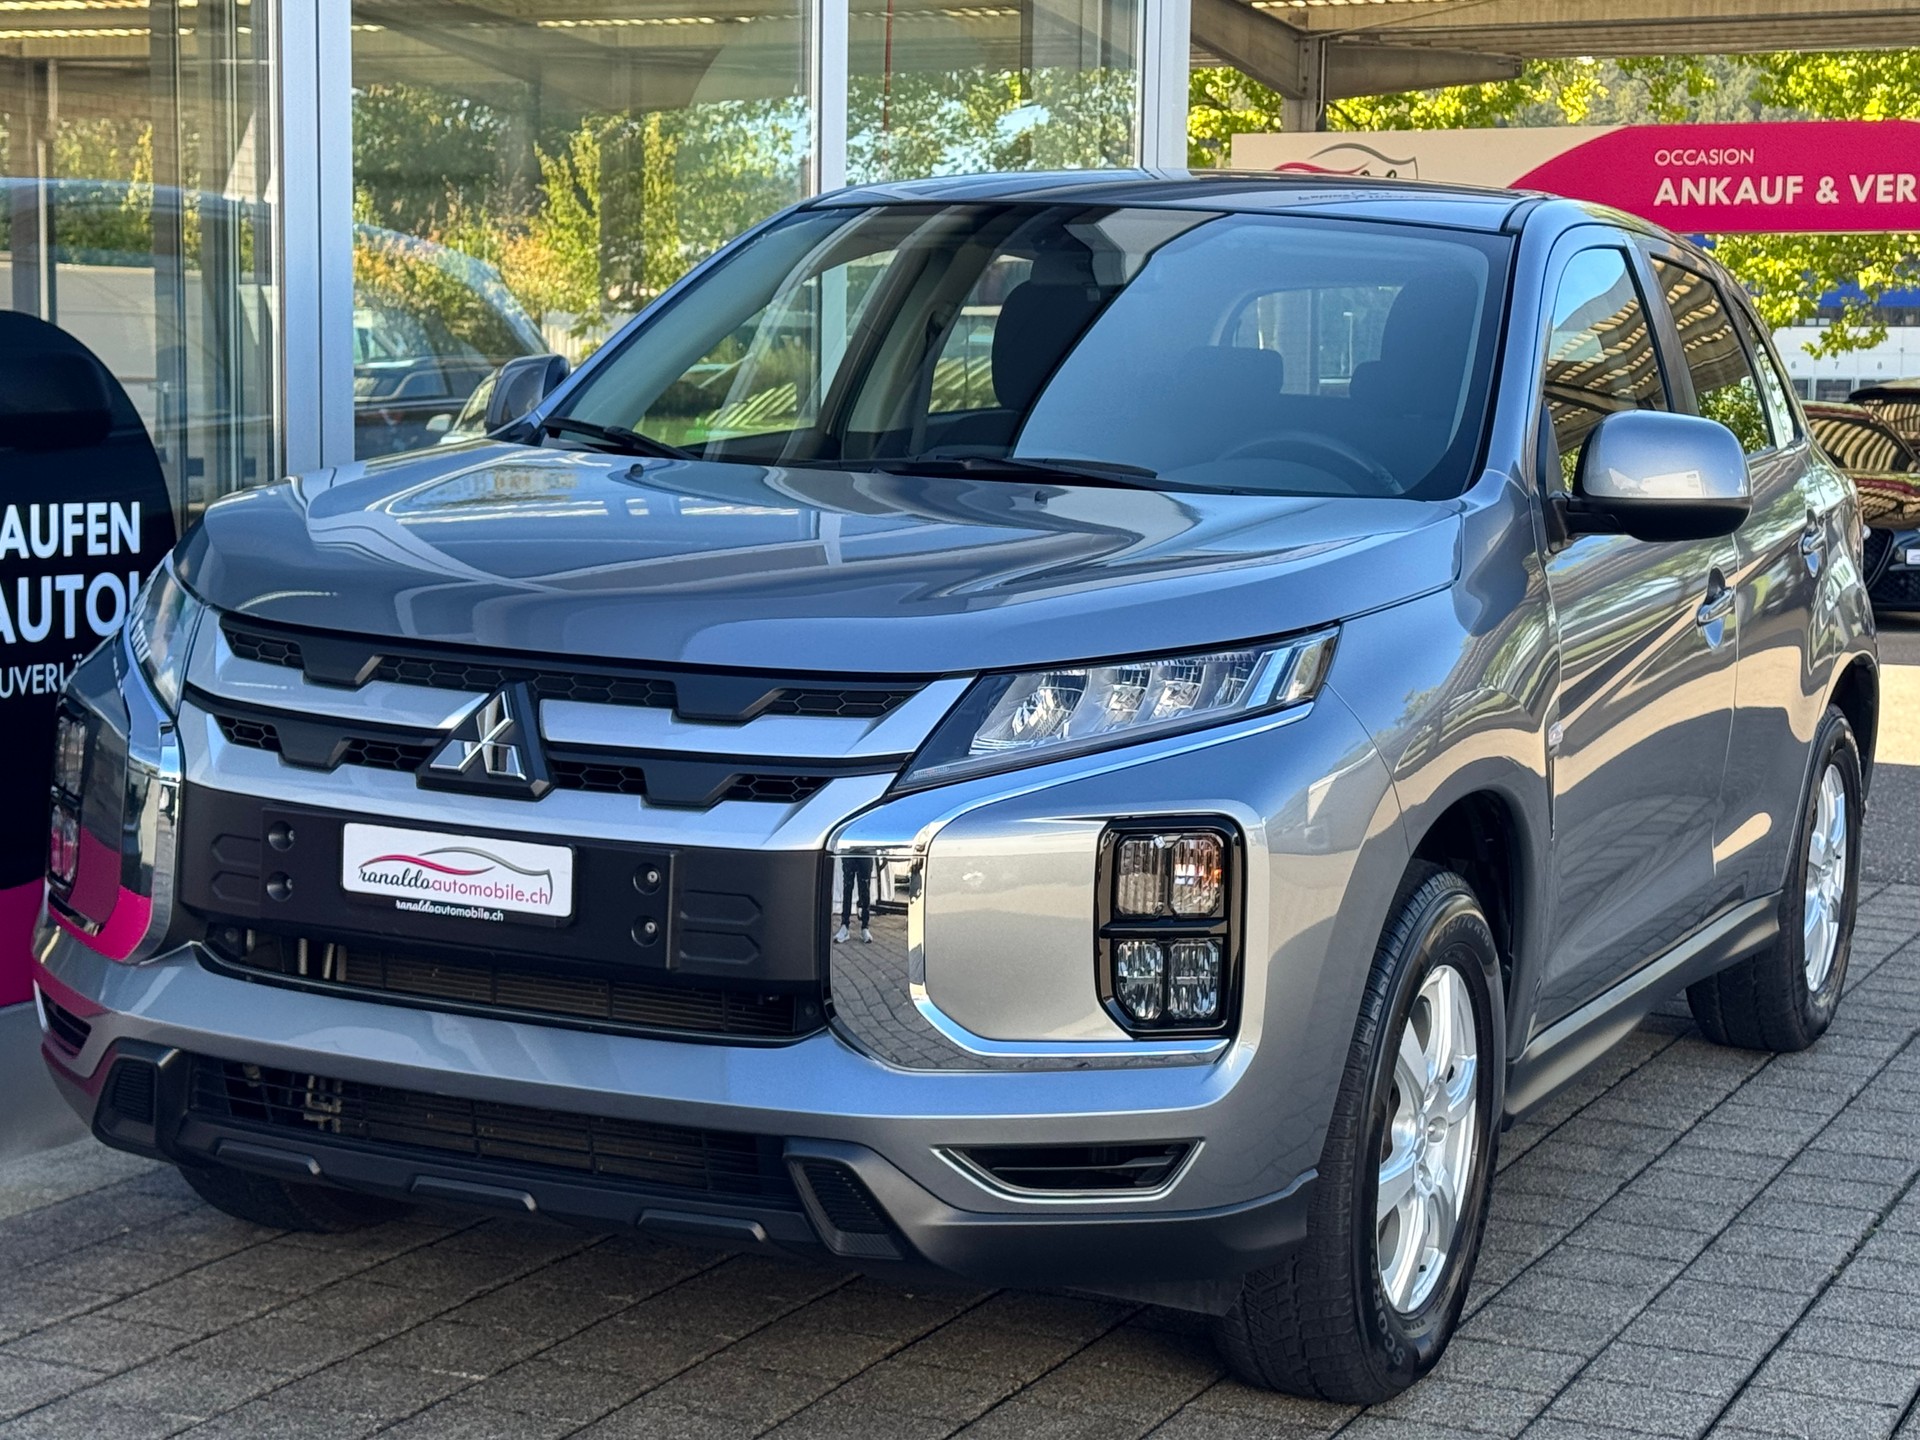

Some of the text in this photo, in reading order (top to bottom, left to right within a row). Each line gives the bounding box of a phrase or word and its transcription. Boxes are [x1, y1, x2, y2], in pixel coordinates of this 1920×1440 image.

[1654, 148, 1754, 167] OCCASION
[1653, 173, 1918, 207] ANKAUF & VER
[358, 866, 549, 905] ranaldoautomobile.ch
[395, 899, 504, 922] ranaldoautomobile.ch
